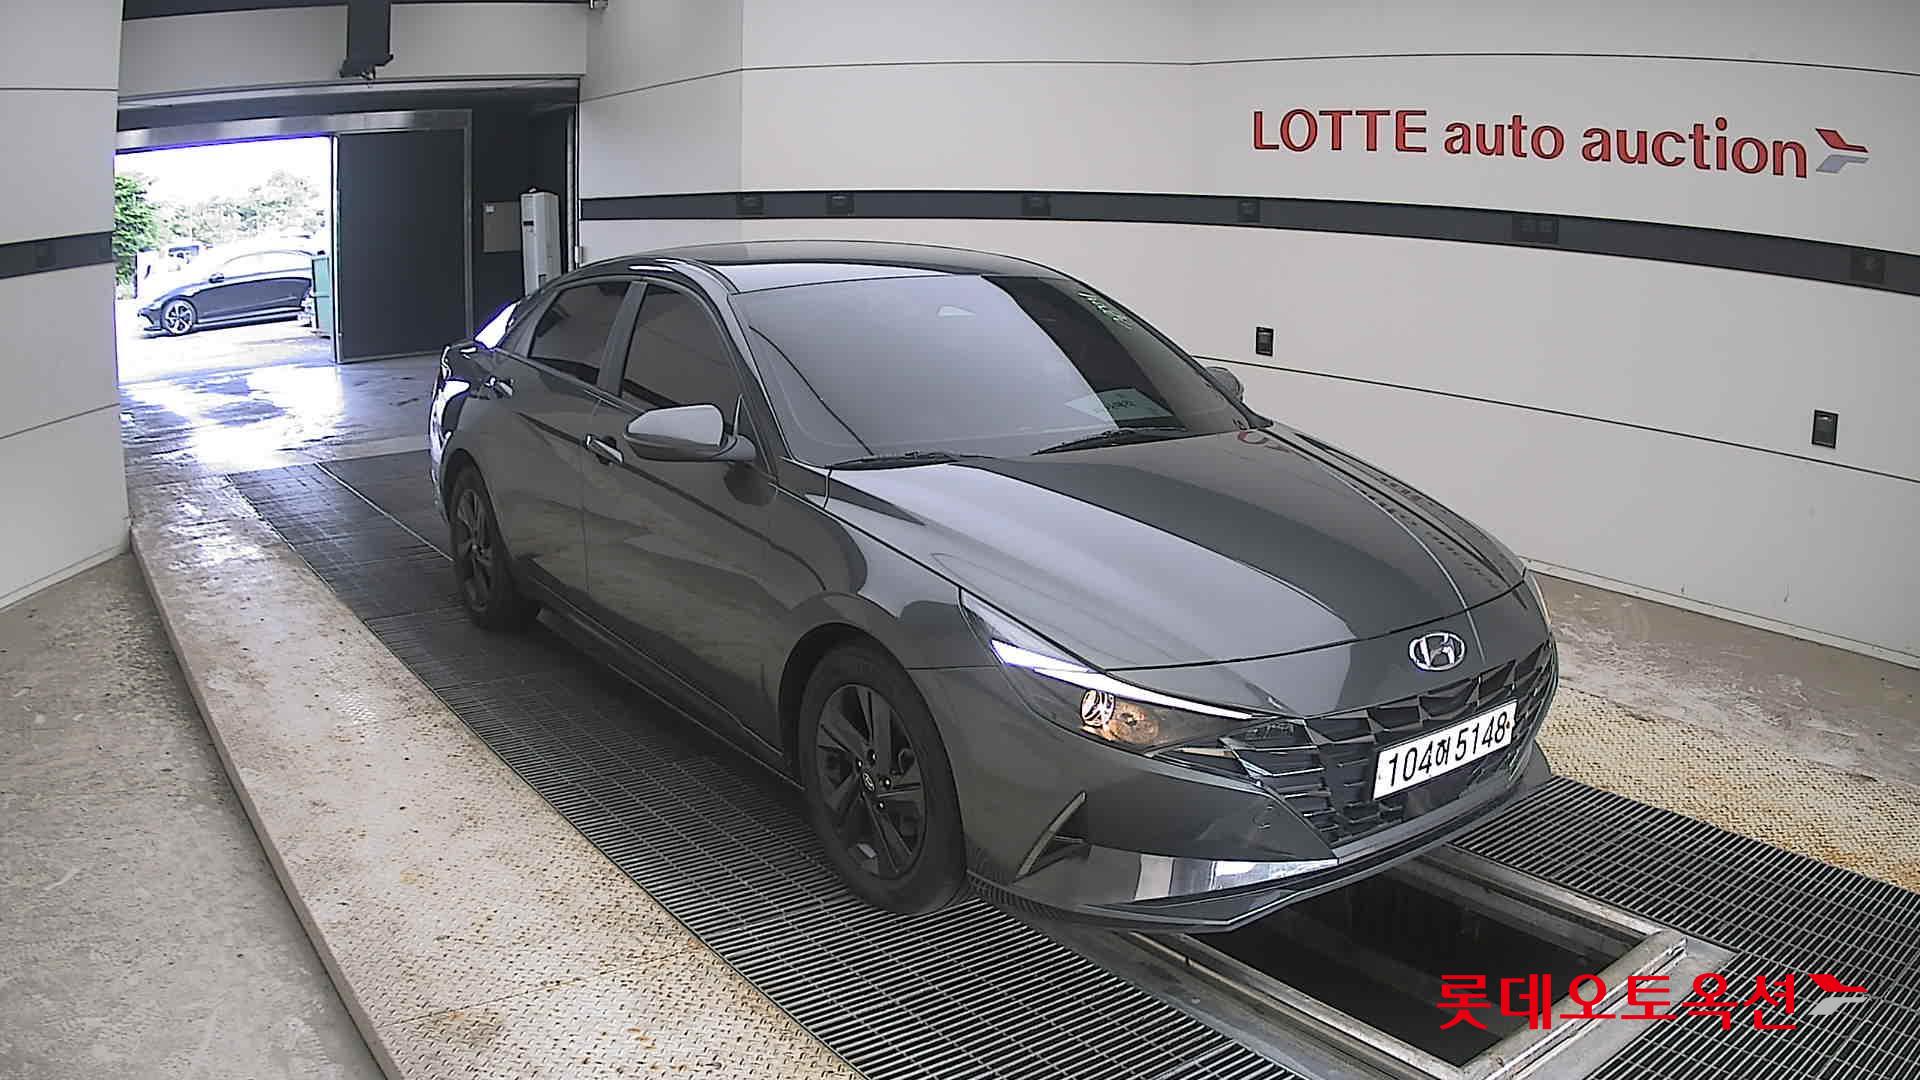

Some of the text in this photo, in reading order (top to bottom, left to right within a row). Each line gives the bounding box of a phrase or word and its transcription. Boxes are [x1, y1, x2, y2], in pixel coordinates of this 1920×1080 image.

[1252, 109, 1810, 178] LOTTE auto auction
